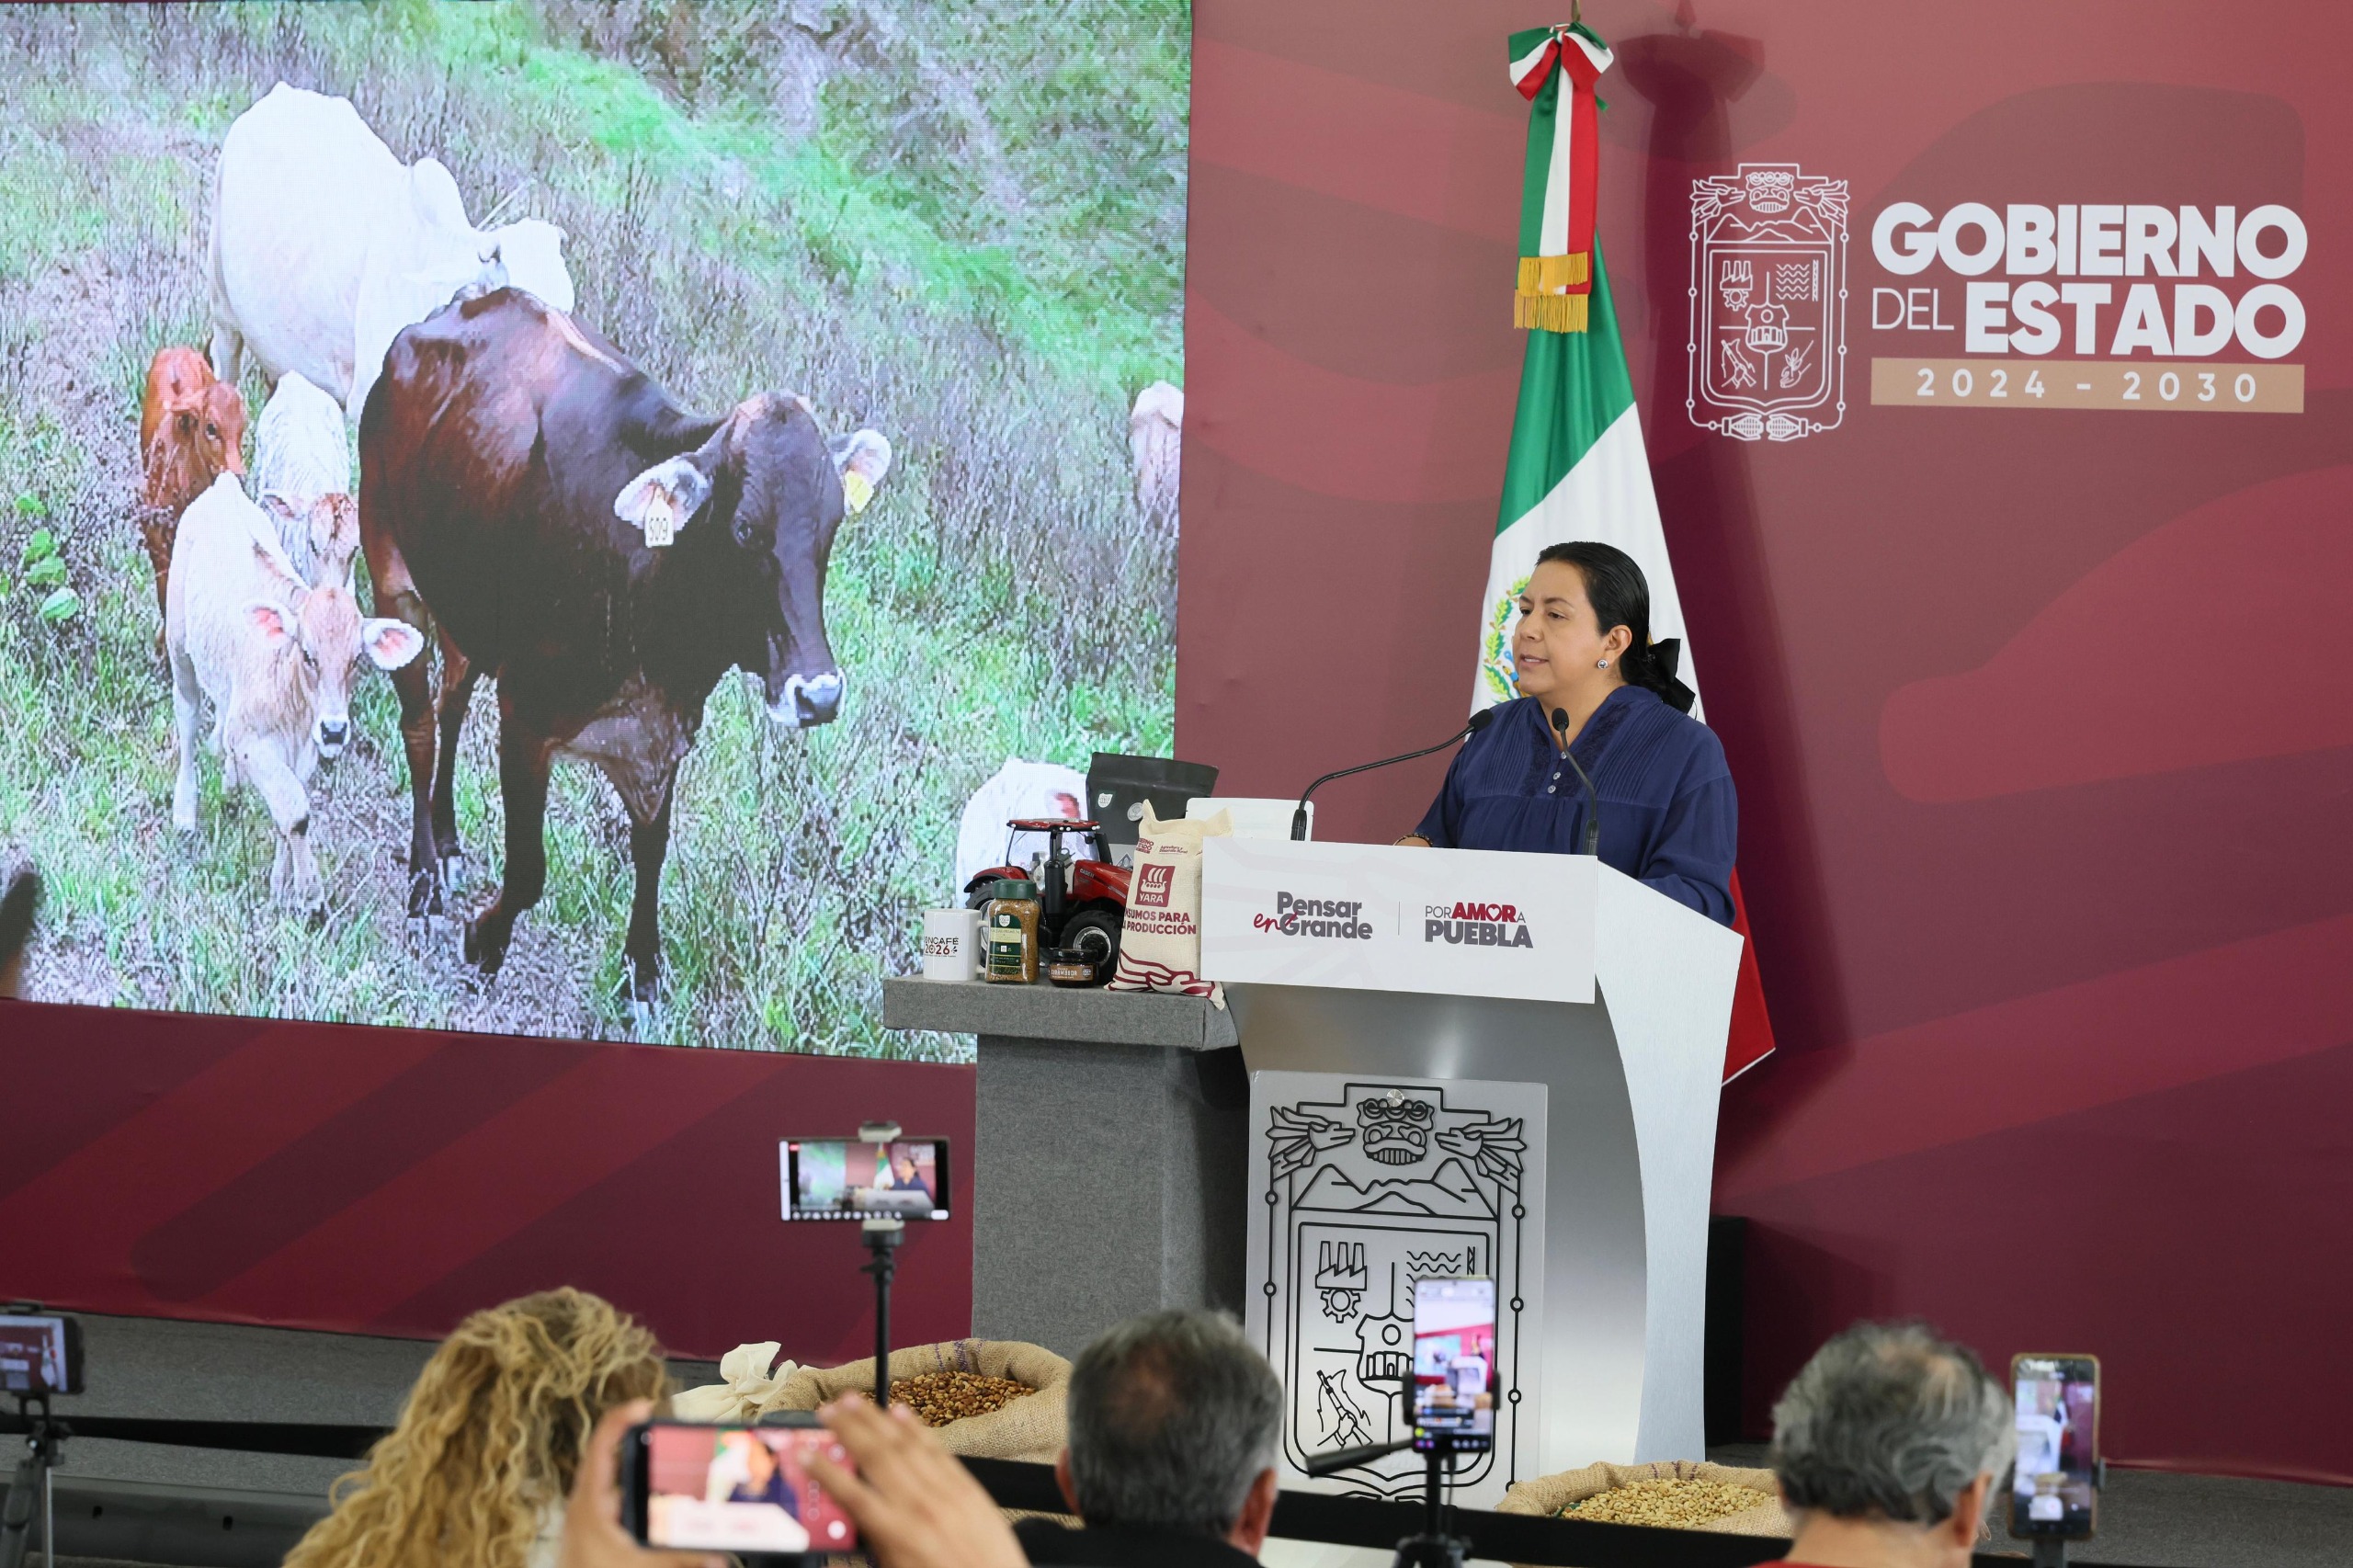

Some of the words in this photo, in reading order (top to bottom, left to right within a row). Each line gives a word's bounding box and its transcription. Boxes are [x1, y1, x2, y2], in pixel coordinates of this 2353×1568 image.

[1871, 201, 2308, 279] GOBIERNO
[1871, 287, 1954, 331] DEL
[1965, 281, 2307, 359] ESTADO
[1916, 368, 2045, 398] 2024
[2122, 371, 2256, 403] 2030
[1139, 892, 1164, 903] YARA
[1277, 891, 1362, 918] Pensar
[1158, 911, 1191, 923] PARA
[1253, 913, 1286, 934] en
[1279, 913, 1373, 940] Grande
[1425, 905, 1451, 919] POR
[1451, 902, 1518, 924] AMOR
[1517, 911, 1527, 924] A
[1127, 920, 1197, 935] PRODUCCIÓN
[1425, 919, 1534, 949] PUEBLA
[925, 944, 950, 955] 2026
